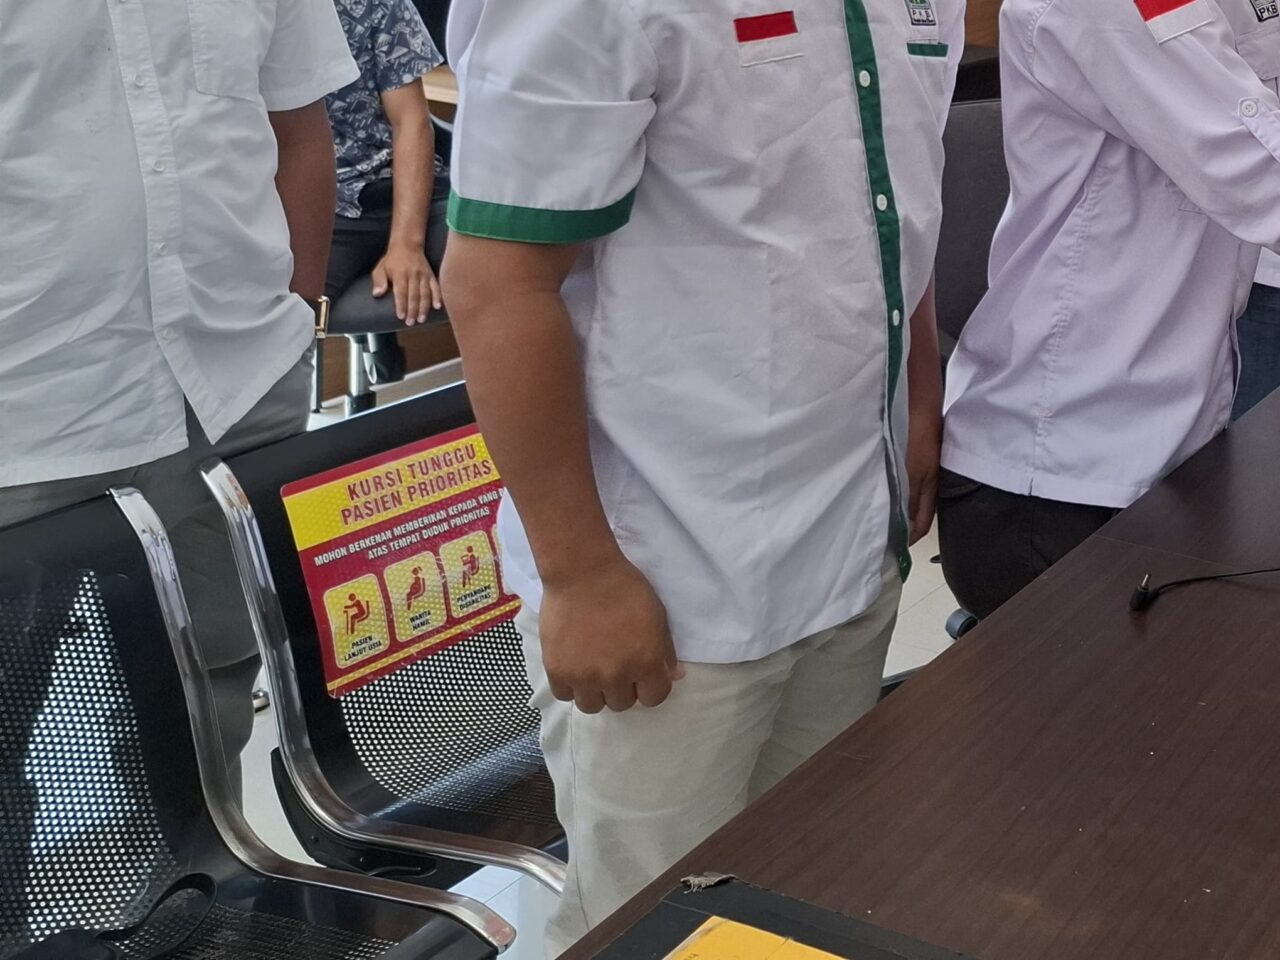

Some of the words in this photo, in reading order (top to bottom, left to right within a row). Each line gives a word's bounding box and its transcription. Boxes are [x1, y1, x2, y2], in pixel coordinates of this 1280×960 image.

[1258, 3, 1278, 18] PKB
[341, 492, 402, 525] PASIEN
[408, 460, 492, 502] PRIORITAS
[347, 469, 403, 501] KURSI
[408, 444, 476, 477] TUNGGU
[314, 547, 347, 567] MOHON
[349, 531, 392, 555] BERKENAN
[393, 511, 447, 539] MEMBERIKAN
[448, 500, 478, 517] KEPADA
[478, 491, 499, 507] YANG
[369, 546, 388, 560] ATAS
[389, 535, 421, 553] TEMPAT
[422, 524, 449, 542] DUDUK
[450, 508, 490, 530] PRIORITAS
